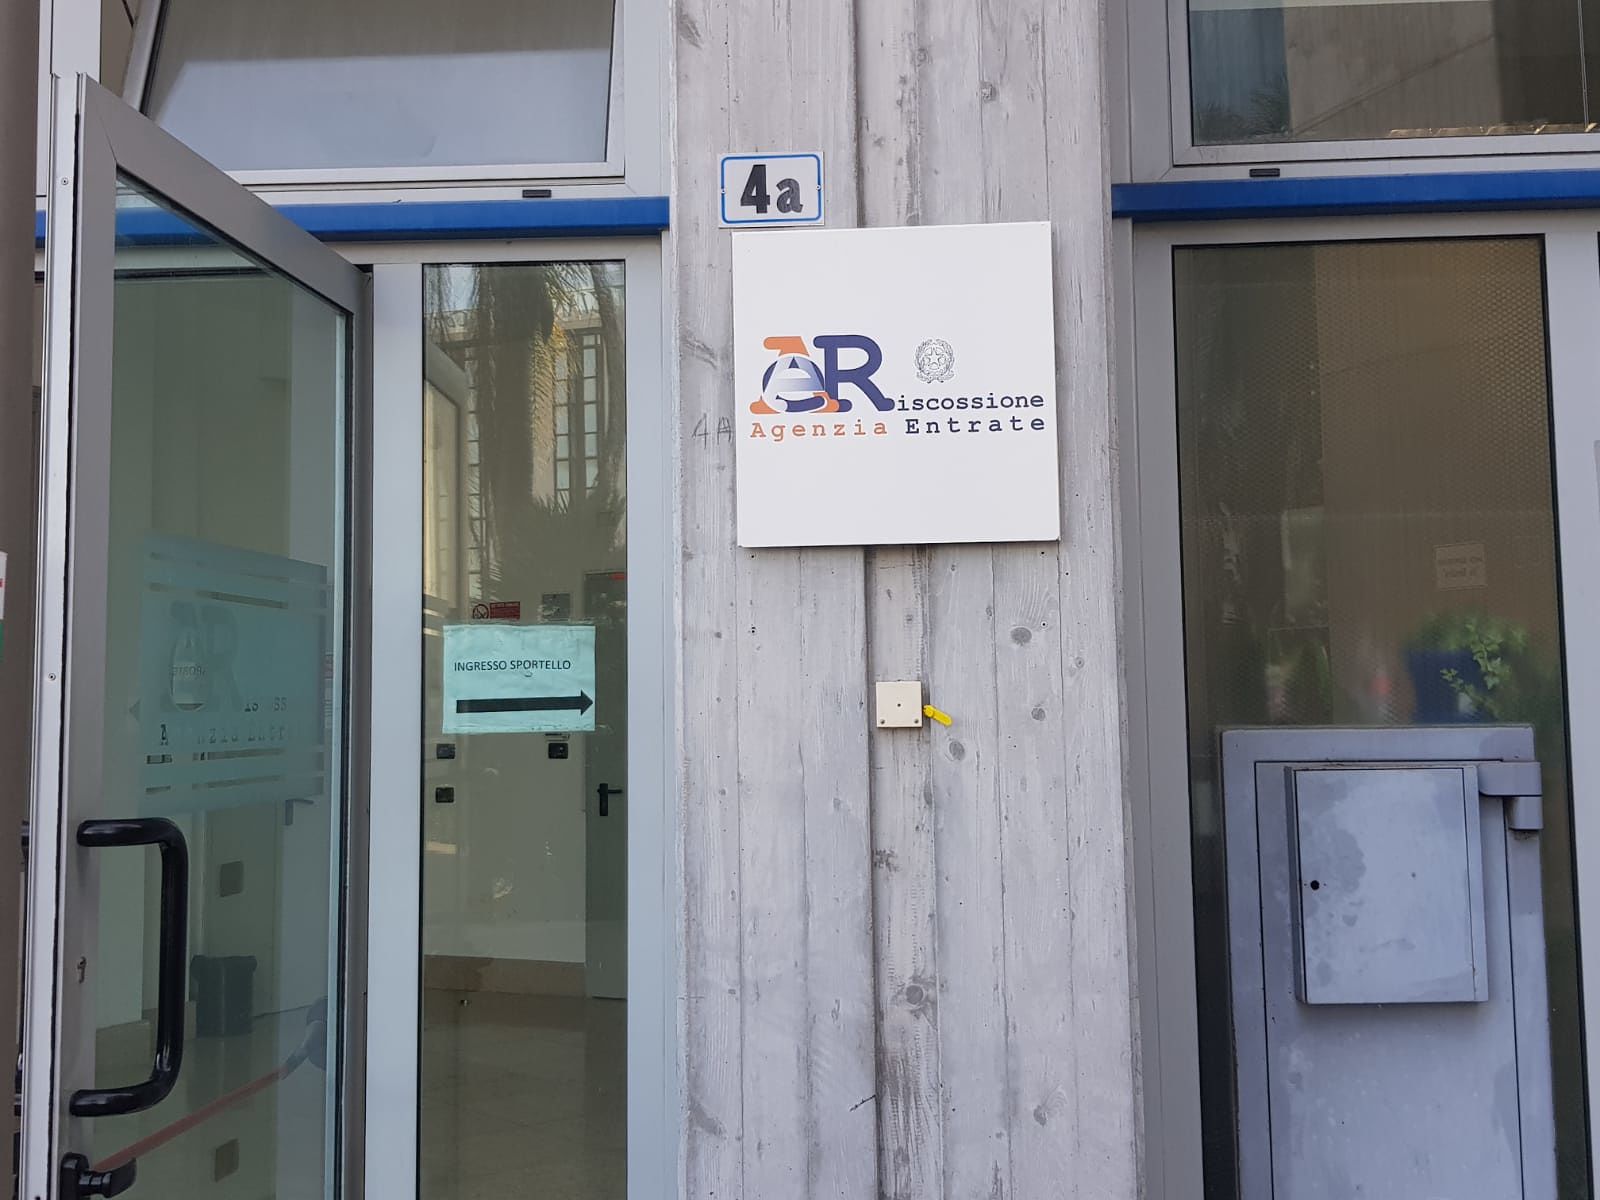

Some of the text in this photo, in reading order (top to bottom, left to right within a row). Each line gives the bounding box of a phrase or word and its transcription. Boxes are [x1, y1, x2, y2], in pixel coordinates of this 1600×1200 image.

[740, 163, 803, 214] 4a
[691, 412, 732, 451] 4A
[749, 415, 1046, 442] Agenzia Entrate
[453, 659, 571, 672] INGRESSO SPORTELLO
